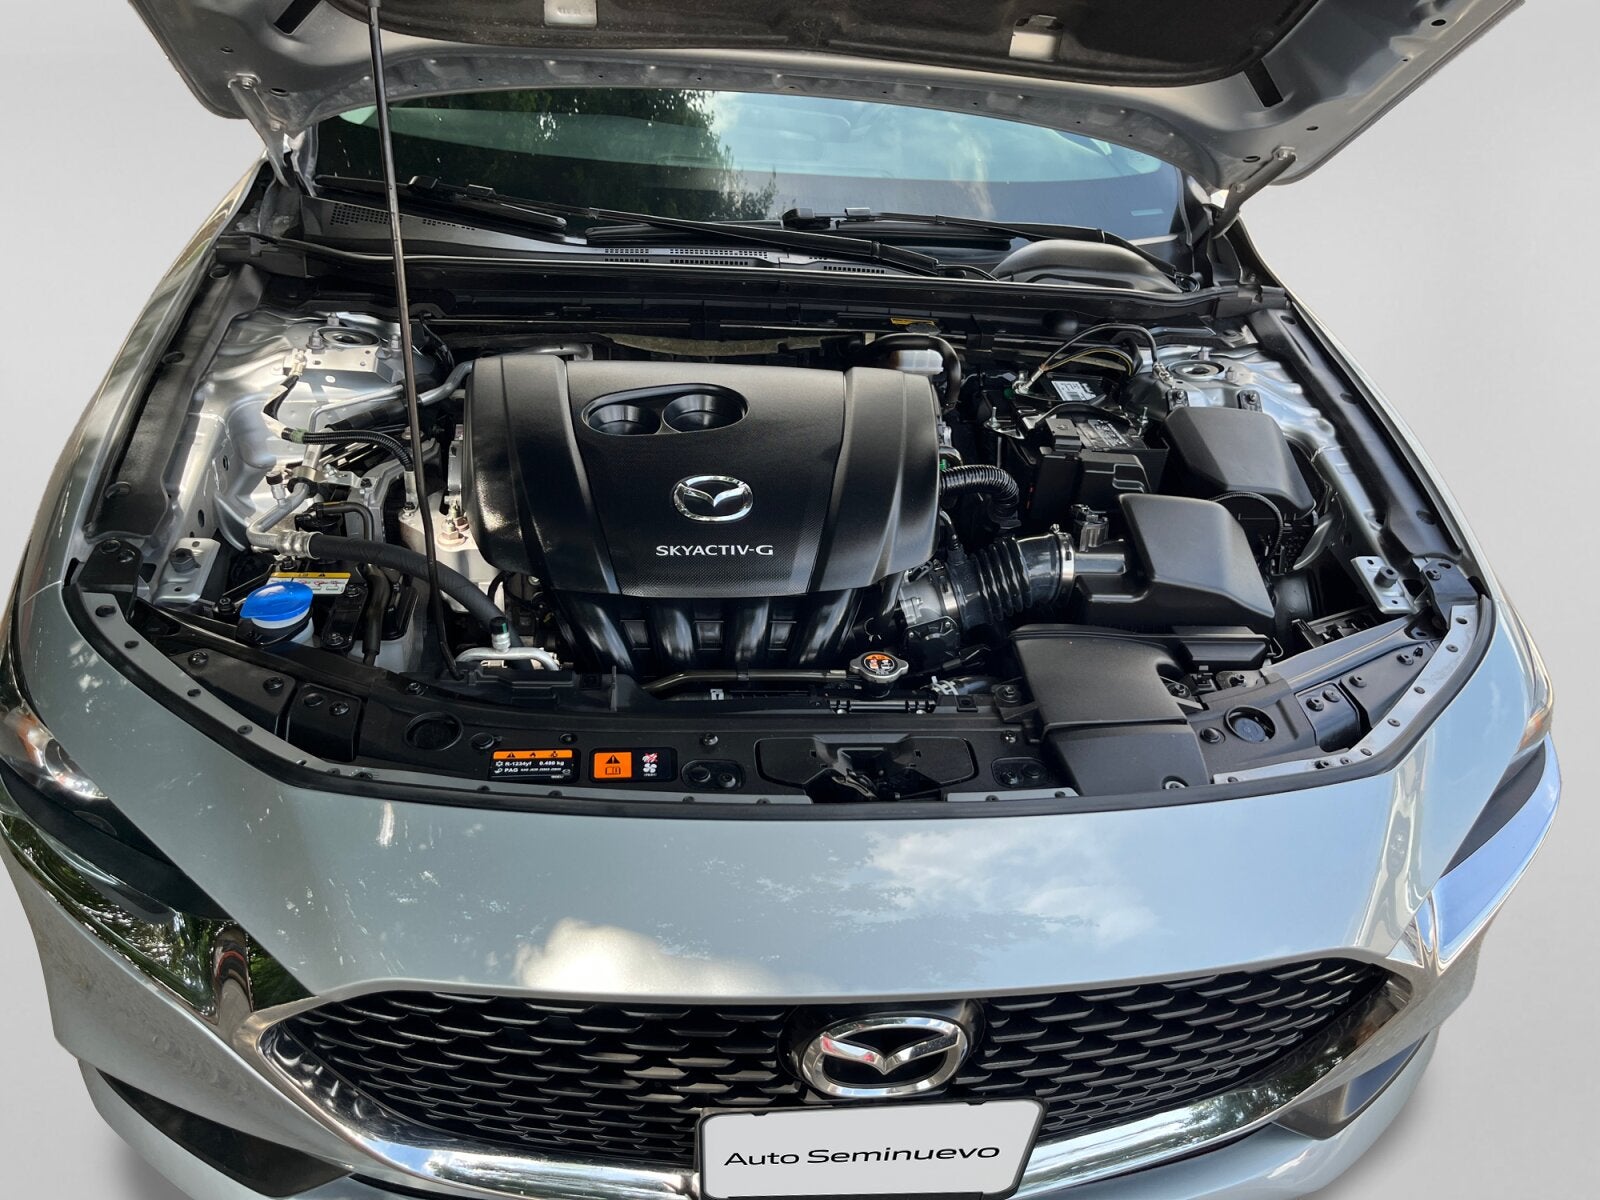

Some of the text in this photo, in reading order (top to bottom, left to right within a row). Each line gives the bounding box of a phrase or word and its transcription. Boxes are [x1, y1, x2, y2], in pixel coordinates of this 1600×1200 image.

[655, 544, 774, 556] SKYACTIV-G
[724, 1146, 1000, 1165] Auto Seminuevo
